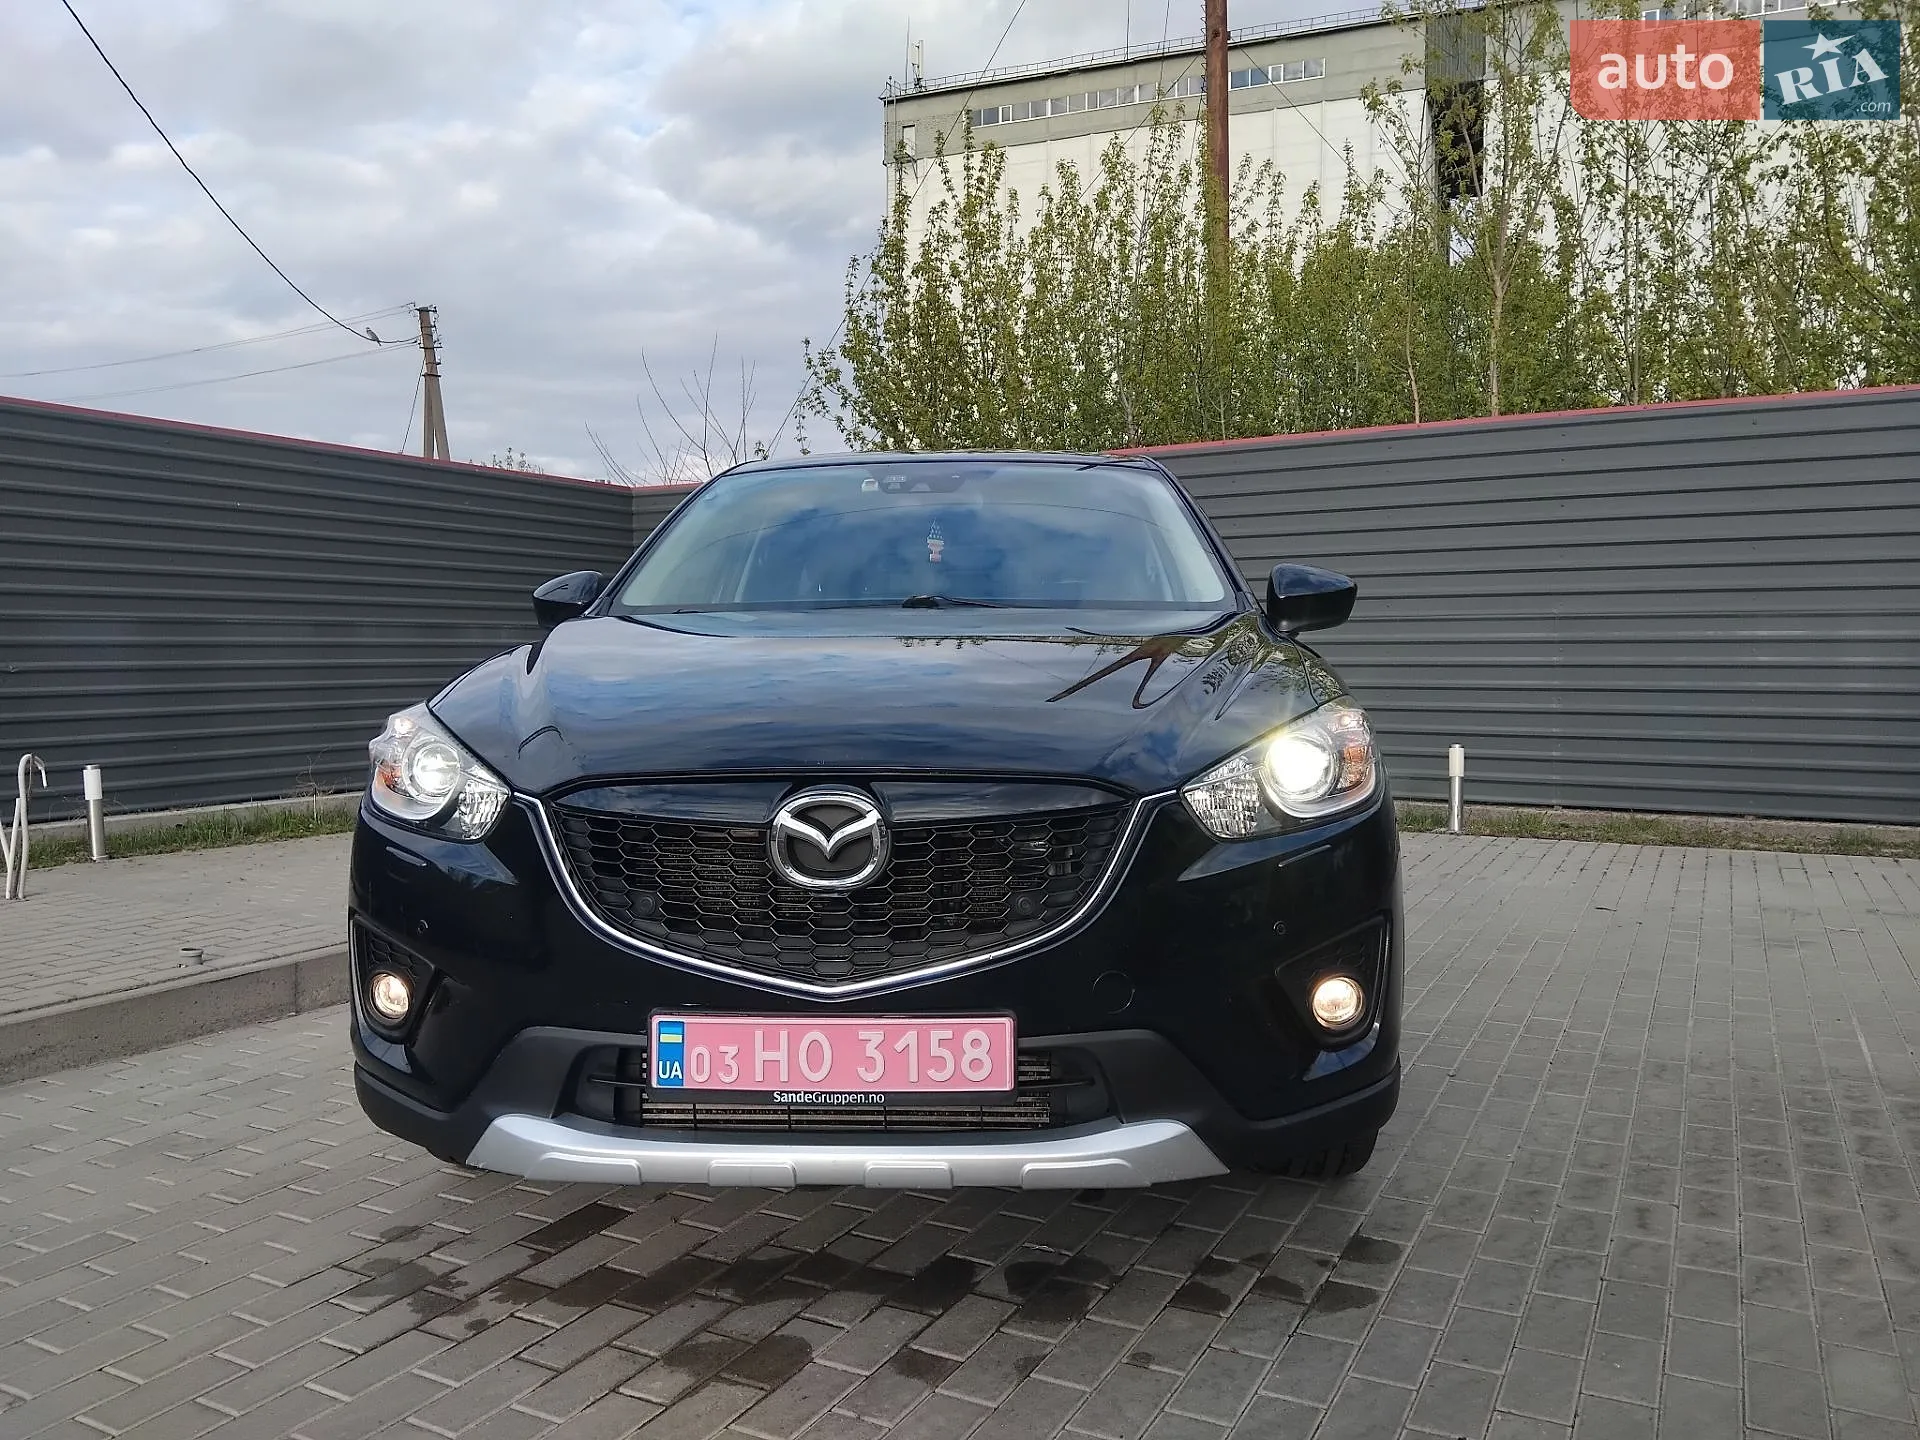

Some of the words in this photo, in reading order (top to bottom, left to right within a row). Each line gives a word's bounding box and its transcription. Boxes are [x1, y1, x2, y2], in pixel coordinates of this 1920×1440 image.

[658, 1060, 683, 1079] UA
[690, 1046, 740, 1084] 03
[754, 1030, 833, 1083] HO
[856, 1030, 993, 1083] 3158
[773, 1090, 885, 1105] SandeGruppen.no
